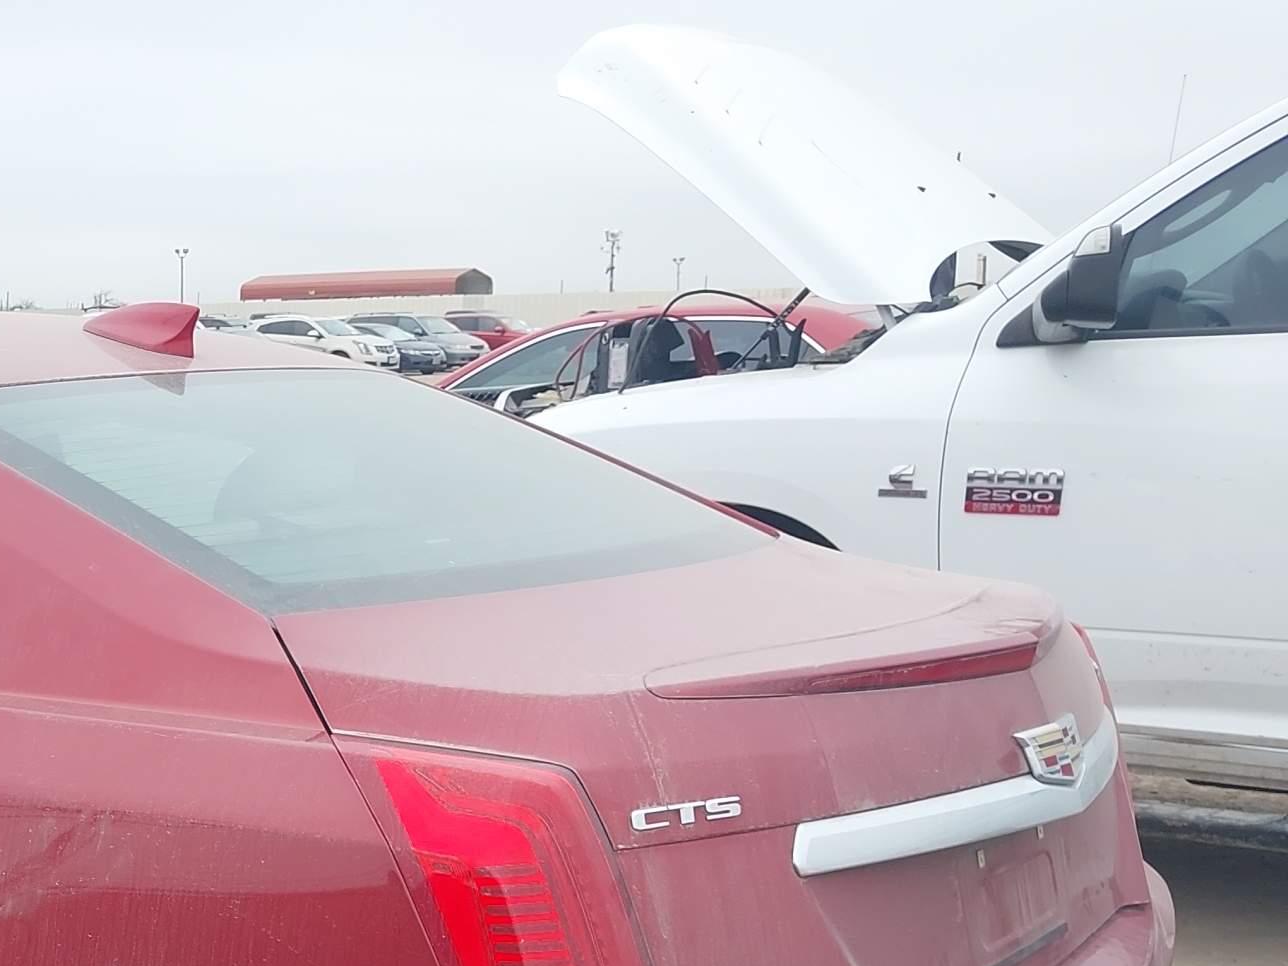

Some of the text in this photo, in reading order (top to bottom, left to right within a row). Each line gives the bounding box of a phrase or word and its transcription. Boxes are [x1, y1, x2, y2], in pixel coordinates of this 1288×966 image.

[966, 468, 1065, 486] RAM
[971, 488, 1055, 503] 2500
[972, 501, 1053, 514] HEAVY DUTY
[630, 796, 742, 831] CTS
